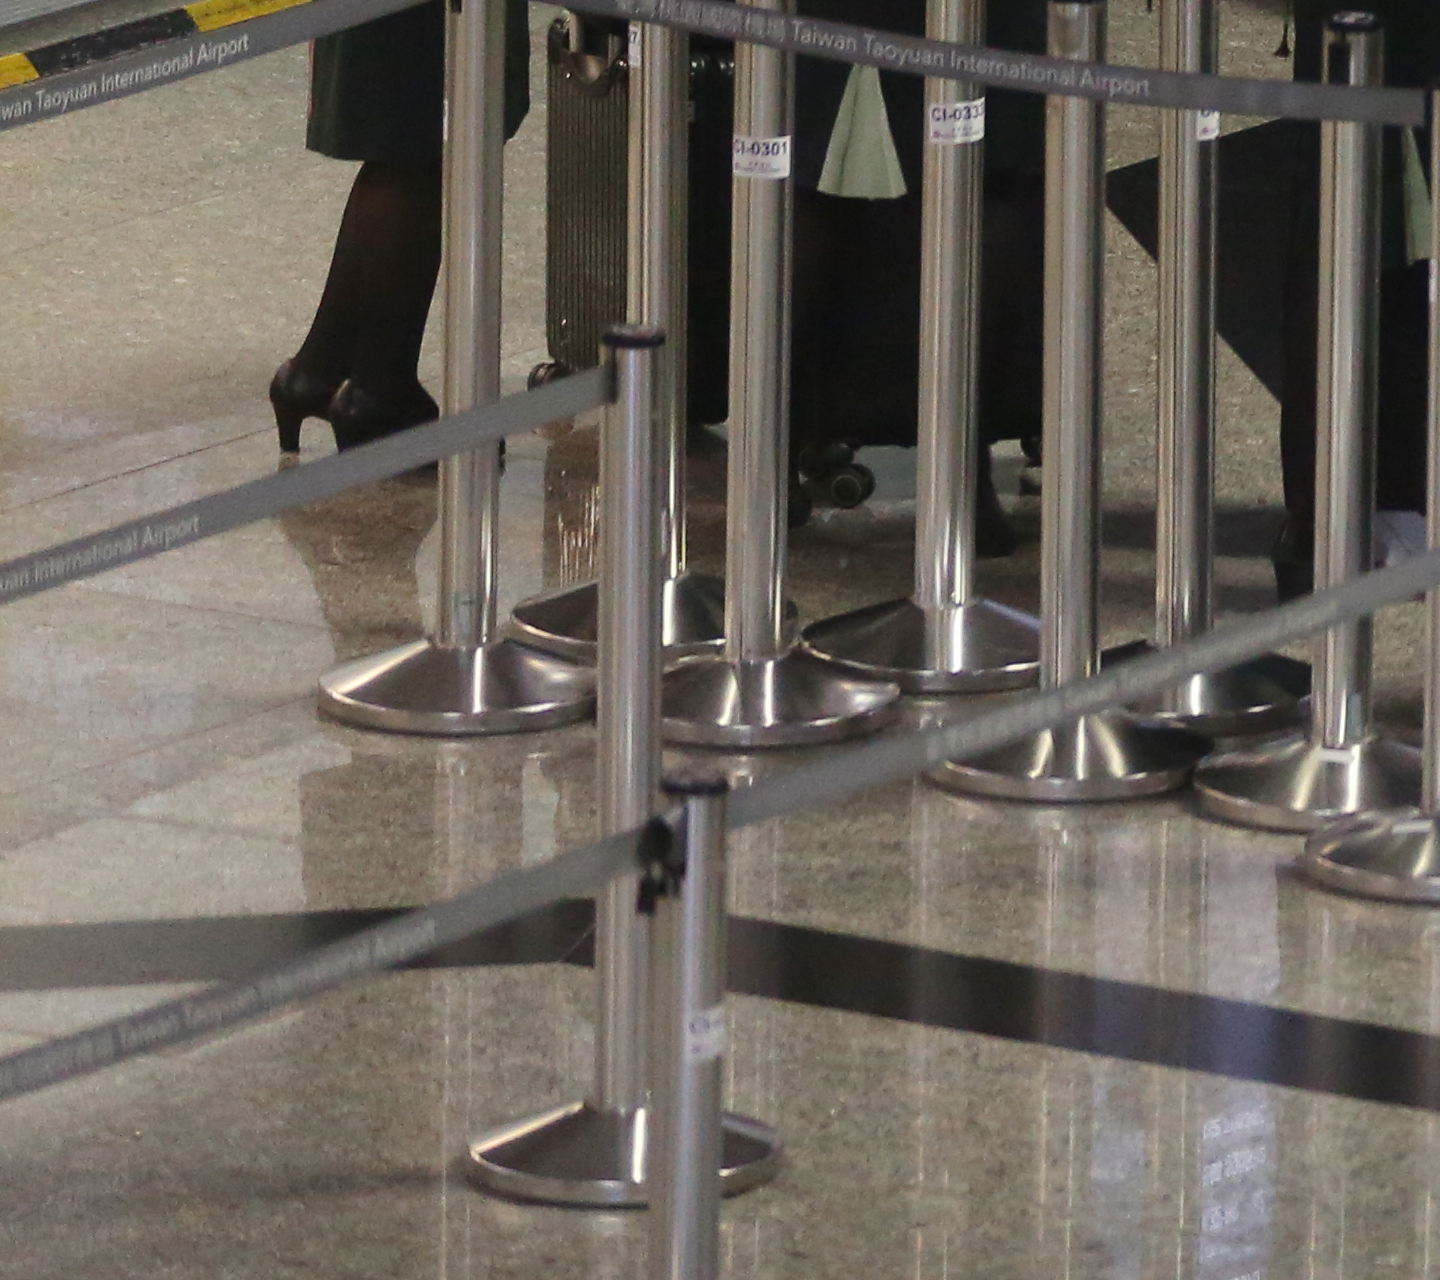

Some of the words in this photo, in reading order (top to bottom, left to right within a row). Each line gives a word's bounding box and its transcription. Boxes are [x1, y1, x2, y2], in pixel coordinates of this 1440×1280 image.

[35, 83, 97, 113] Taoyuan
[100, 46, 193, 93] International
[196, 33, 249, 67] Airport
[792, 20, 858, 54] Taiwan
[863, 32, 946, 69] Taoyuan
[950, 48, 1078, 90] International
[1080, 67, 1151, 100] Airport
[141, 515, 201, 552] Airport
